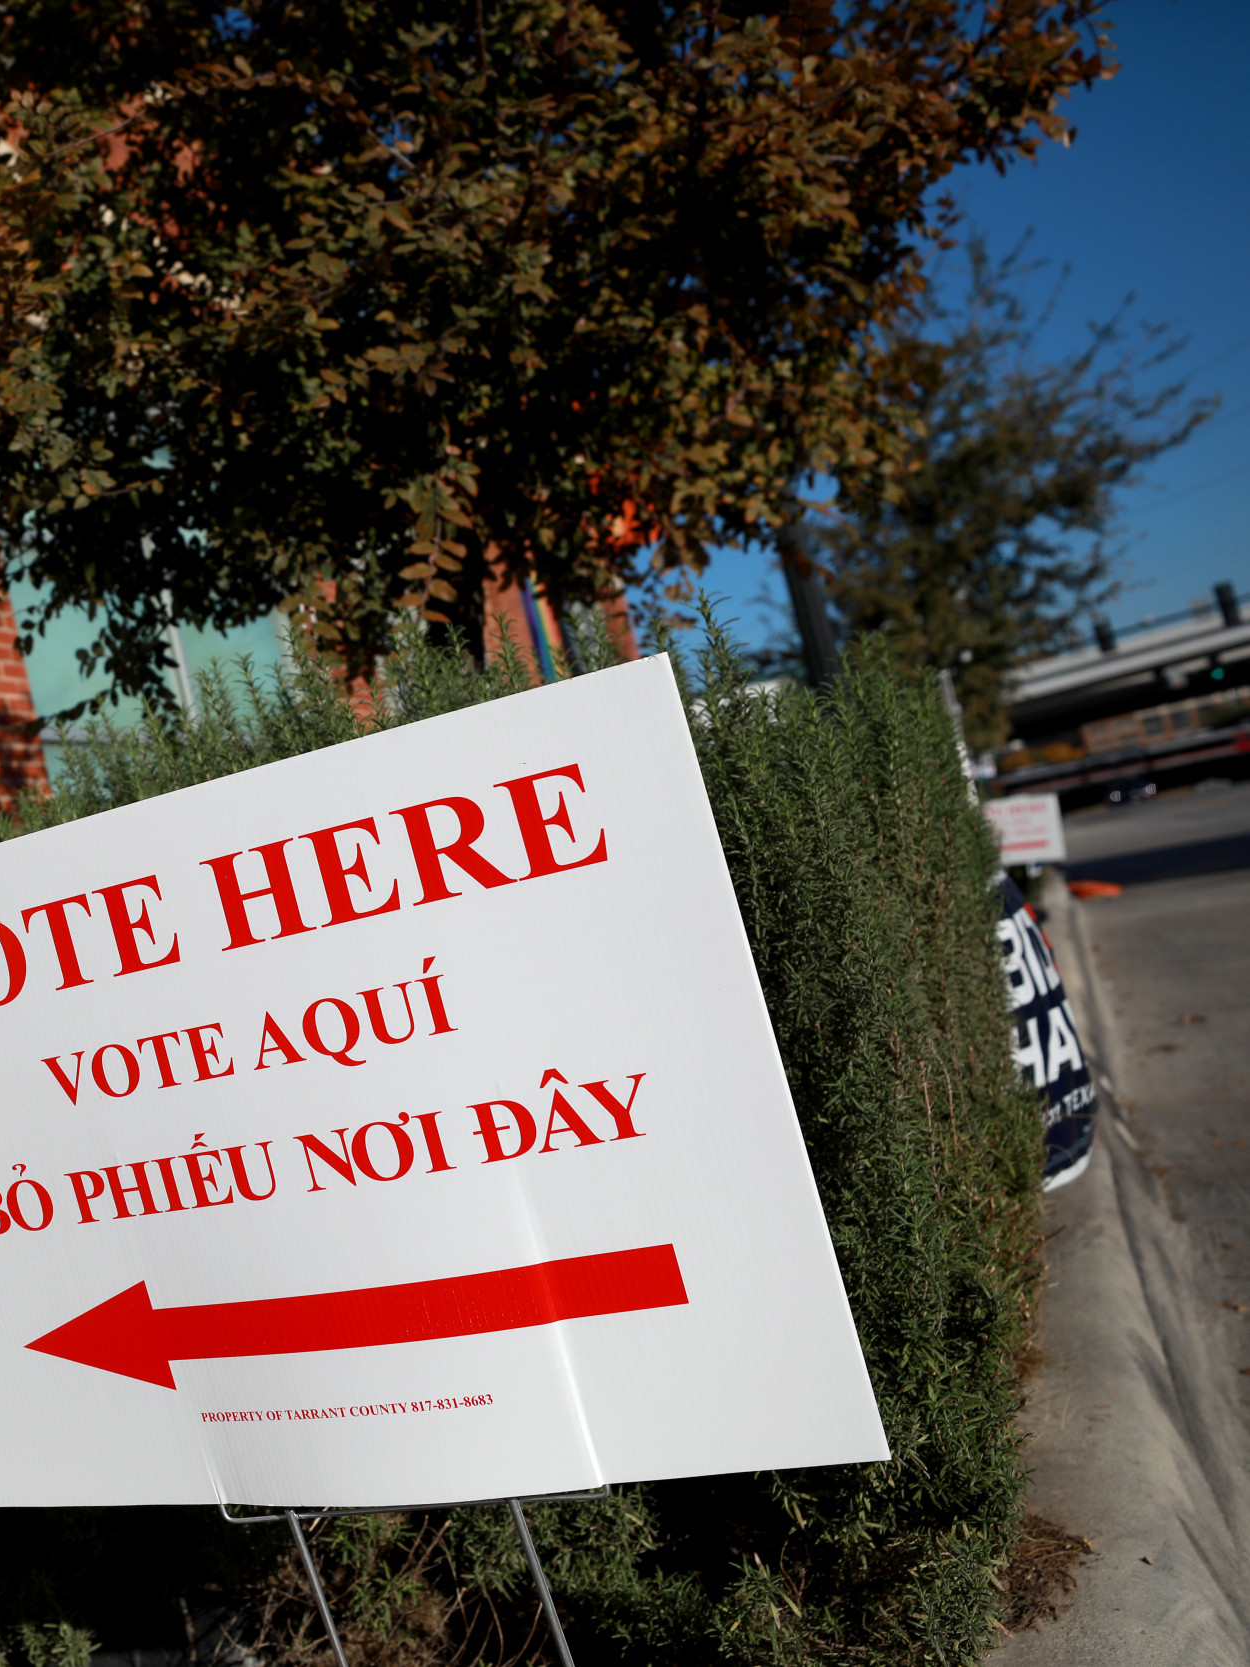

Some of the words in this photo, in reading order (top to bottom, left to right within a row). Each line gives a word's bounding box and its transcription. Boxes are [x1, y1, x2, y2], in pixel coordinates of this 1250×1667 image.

[199, 763, 609, 952] HERE
[41, 1022, 235, 1106] VOTE
[253, 956, 459, 1071] AQUÍ
[64, 1132, 277, 1225] PHIẾU
[293, 1111, 458, 1193] NƠI
[465, 1067, 647, 1165] ĐÂY
[201, 1410, 264, 1423] PROPERTY
[266, 1410, 283, 1421] OF
[284, 1406, 347, 1420] TARRANT
[349, 1402, 408, 1418] COUNTY
[410, 1393, 494, 1413] 817-831-8683
